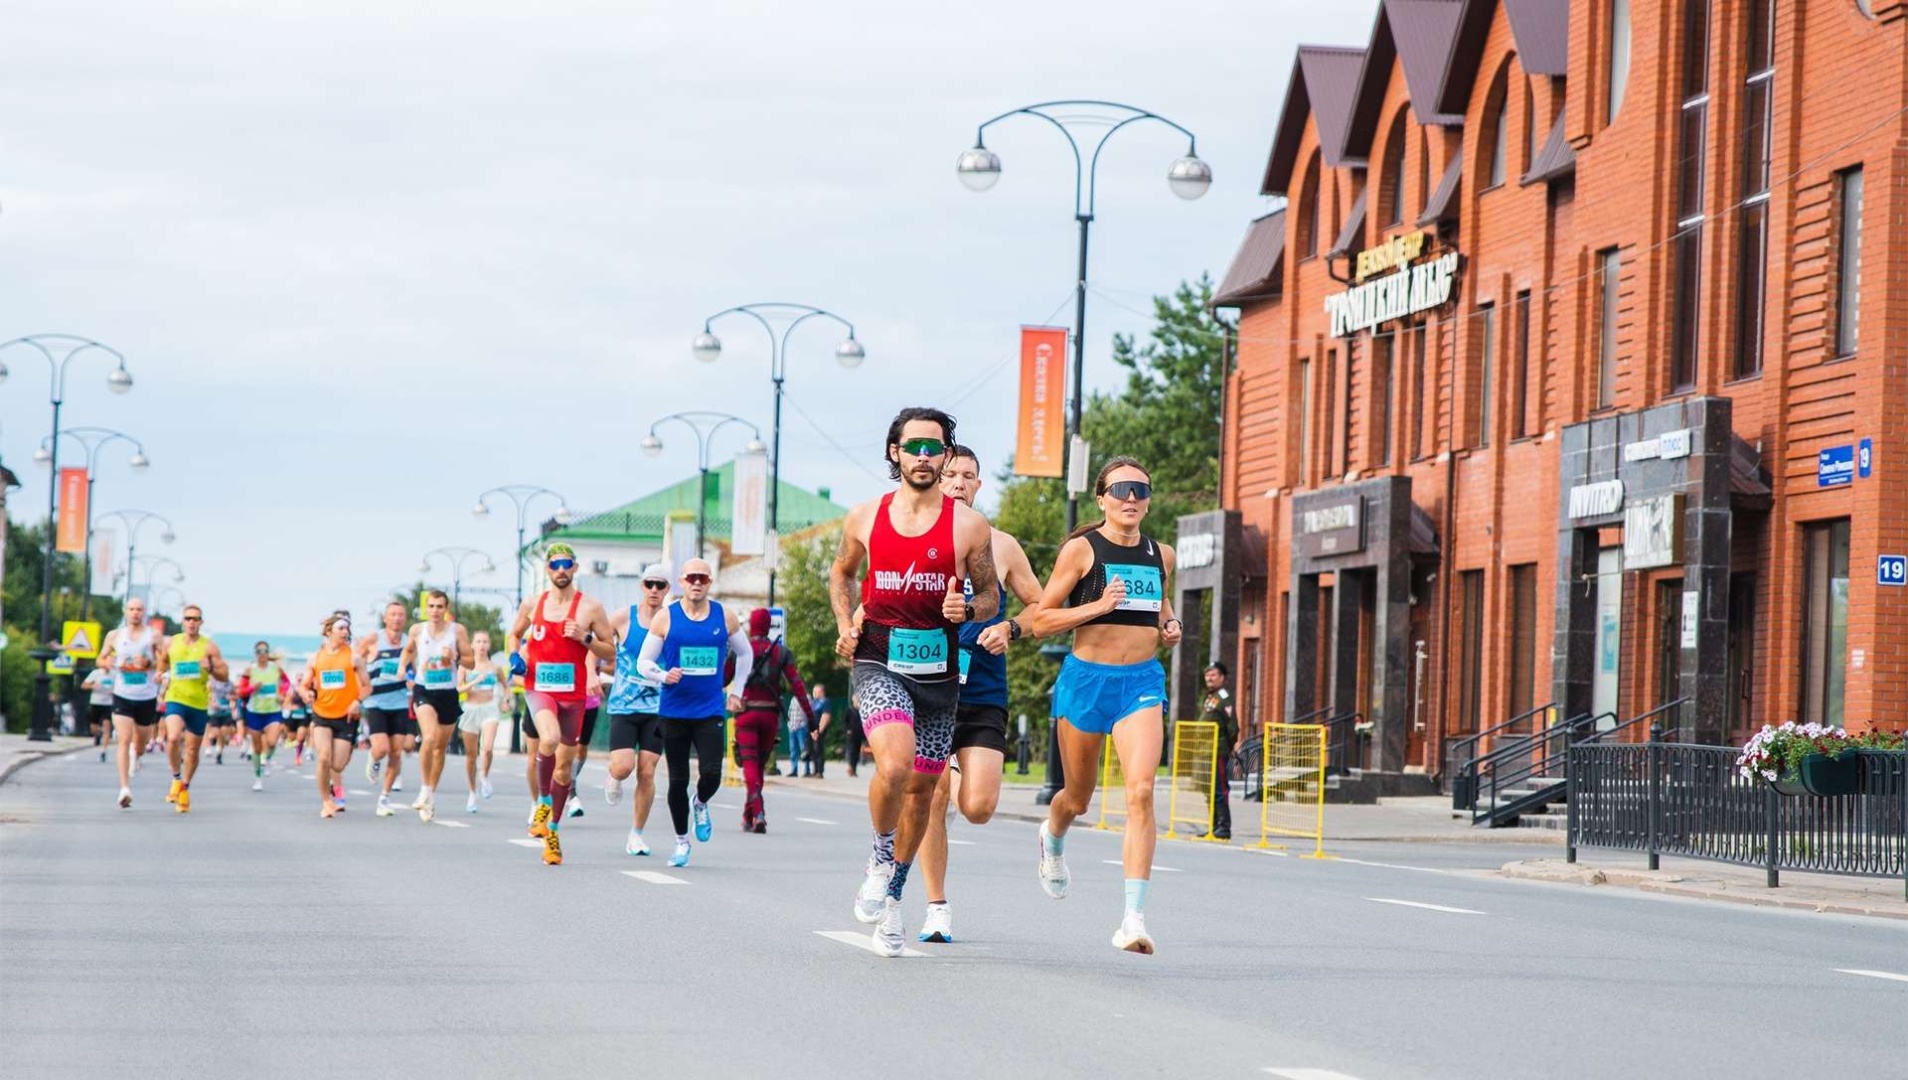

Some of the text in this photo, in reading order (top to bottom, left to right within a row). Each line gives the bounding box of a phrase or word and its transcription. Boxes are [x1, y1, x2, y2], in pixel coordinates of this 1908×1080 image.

[1860, 447, 1870, 469] 19
[1880, 560, 1904, 579] 19
[1123, 579, 1155, 596] 684
[897, 643, 941, 660] 1304
[685, 655, 714, 667] 1432
[540, 671, 570, 683] 1686
